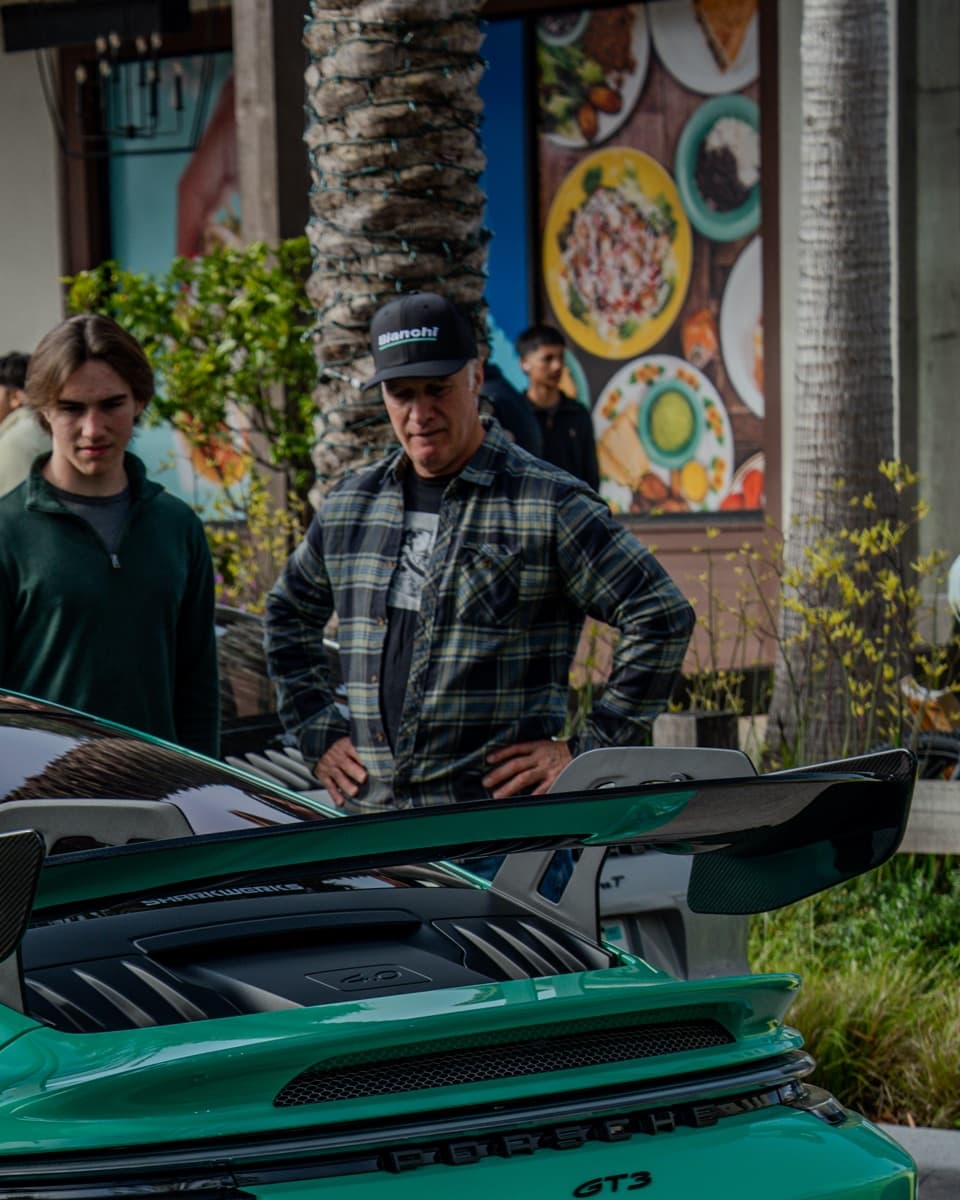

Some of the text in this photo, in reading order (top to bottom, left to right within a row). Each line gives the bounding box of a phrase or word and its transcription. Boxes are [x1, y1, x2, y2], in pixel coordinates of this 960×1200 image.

[378, 326, 439, 346] Bianchi
[390, 1104, 720, 1174] PORSCHE
[572, 1170, 653, 1199] GT3
